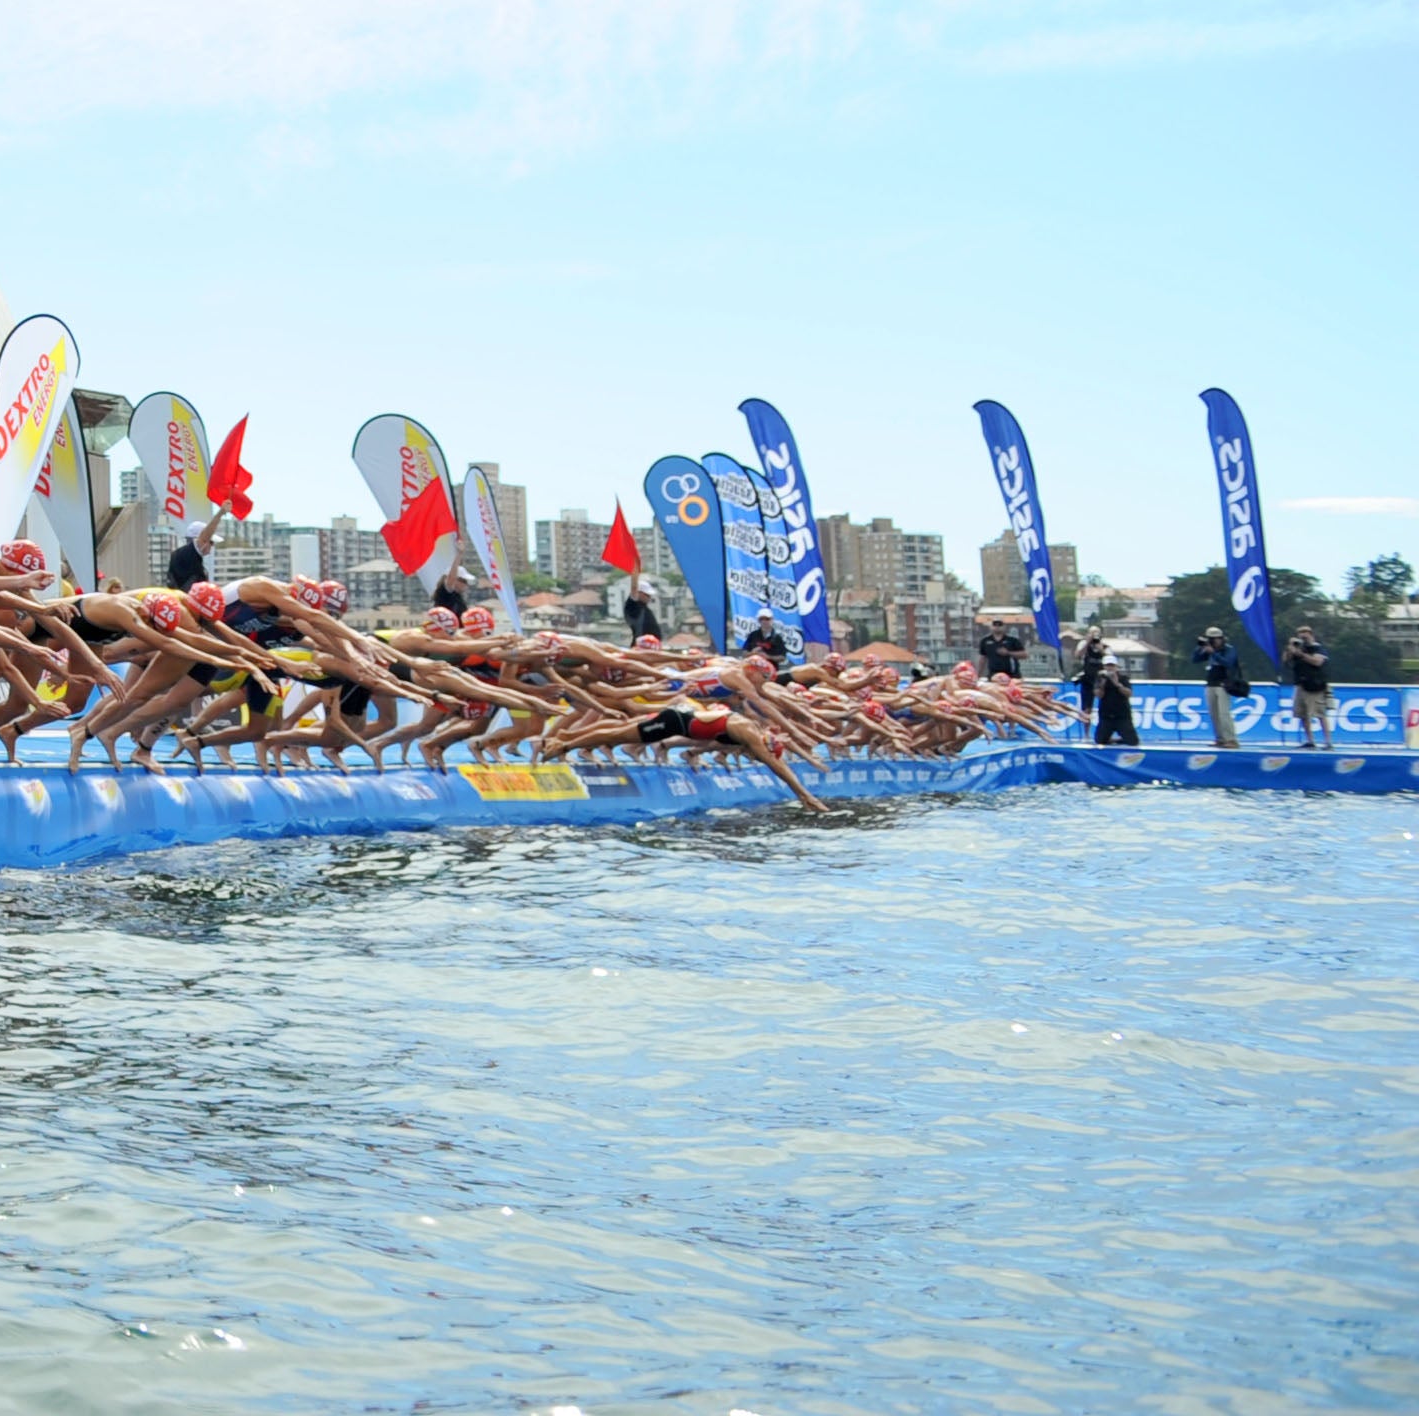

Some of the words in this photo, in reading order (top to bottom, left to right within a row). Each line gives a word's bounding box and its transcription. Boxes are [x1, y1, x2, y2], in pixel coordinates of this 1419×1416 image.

[165, 420, 187, 521] DEXTRO
[22, 553, 41, 570] 63
[205, 595, 222, 613] 12
[160, 605, 176, 623] 26
